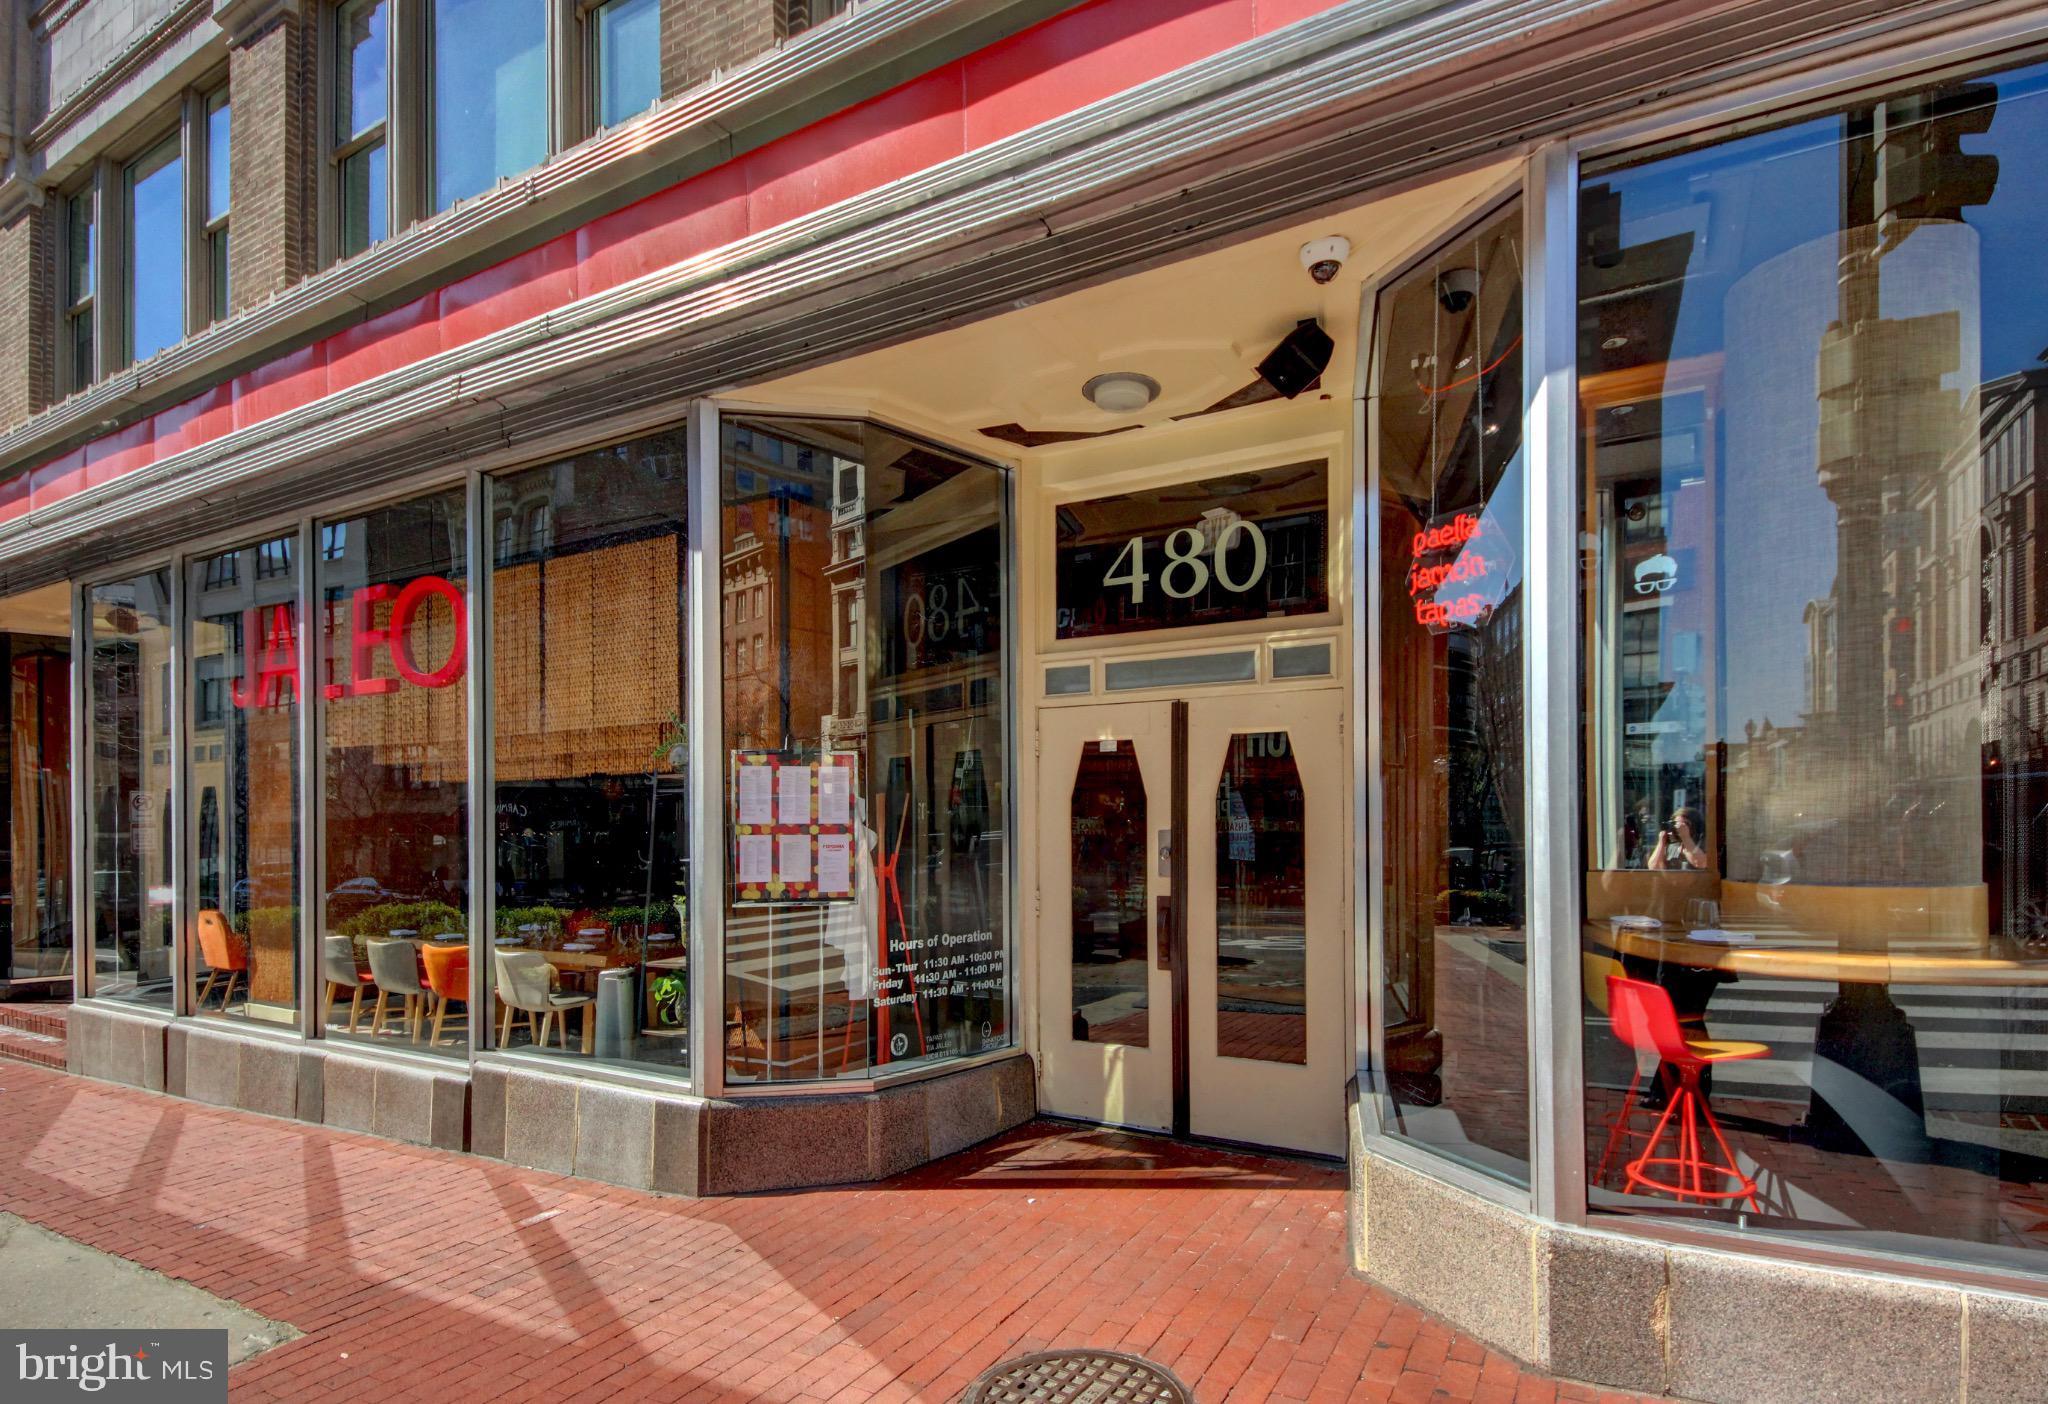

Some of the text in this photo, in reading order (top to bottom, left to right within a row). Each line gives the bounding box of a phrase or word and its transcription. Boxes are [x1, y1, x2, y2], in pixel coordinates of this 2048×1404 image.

[1412, 513, 1484, 558] paella
[1102, 520, 1267, 604] 480
[1409, 549, 1488, 597] jamón
[1416, 593, 1484, 628] tapas
[889, 930, 993, 952] Hours of Operation
[872, 962, 919, 977] Sun-Thur
[923, 957, 949, 970] 11:30
[872, 978, 903, 991] Friday
[915, 971, 940, 984] 11:30
[942, 969, 957, 981] AM
[964, 964, 988, 977] 11:00
[990, 962, 1003, 973] PM
[873, 992, 918, 1008] Saturday
[922, 986, 948, 999] 11:30
[949, 983, 964, 995] AM
[971, 978, 995, 991] 11:00
